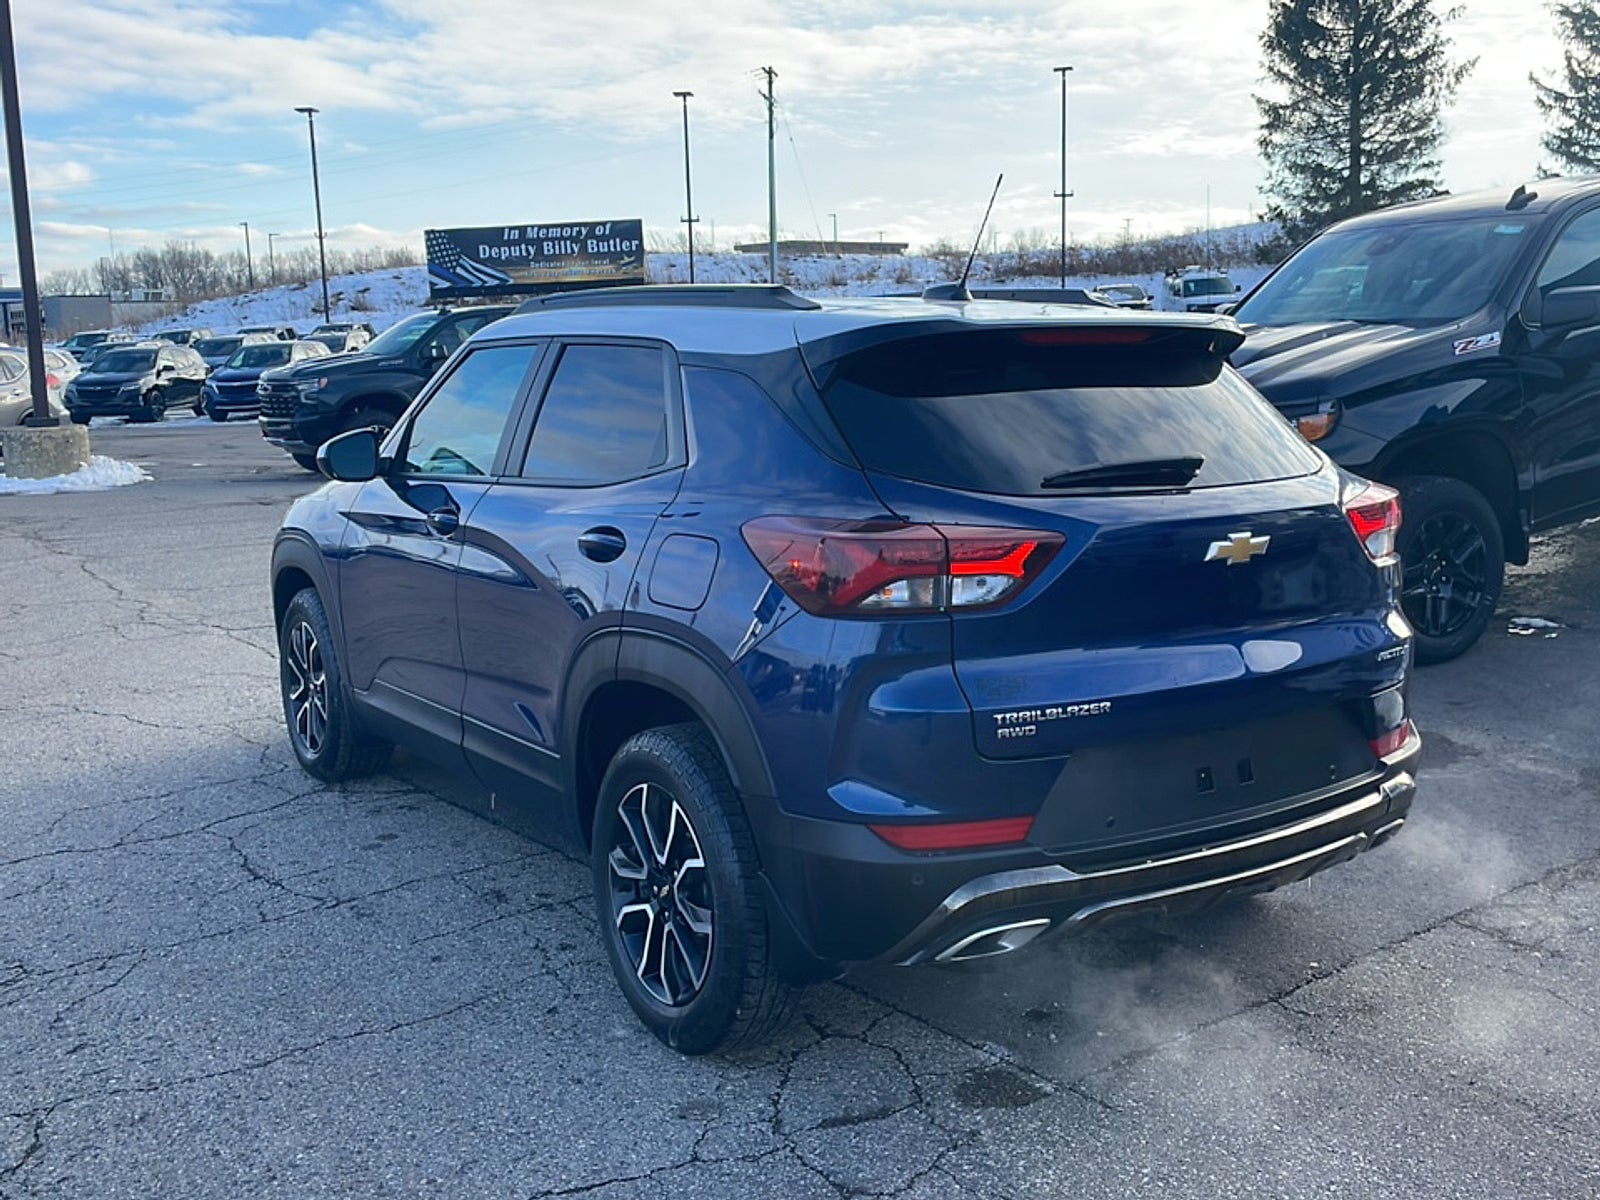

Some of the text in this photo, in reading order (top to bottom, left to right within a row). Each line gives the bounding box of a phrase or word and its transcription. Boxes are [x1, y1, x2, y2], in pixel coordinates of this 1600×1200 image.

[503, 222, 612, 241] In Memory of
[478, 237, 640, 260] Deputy Billy Butler
[993, 701, 1112, 725] TRAILBLAZER
[997, 725, 1037, 739] AWD
